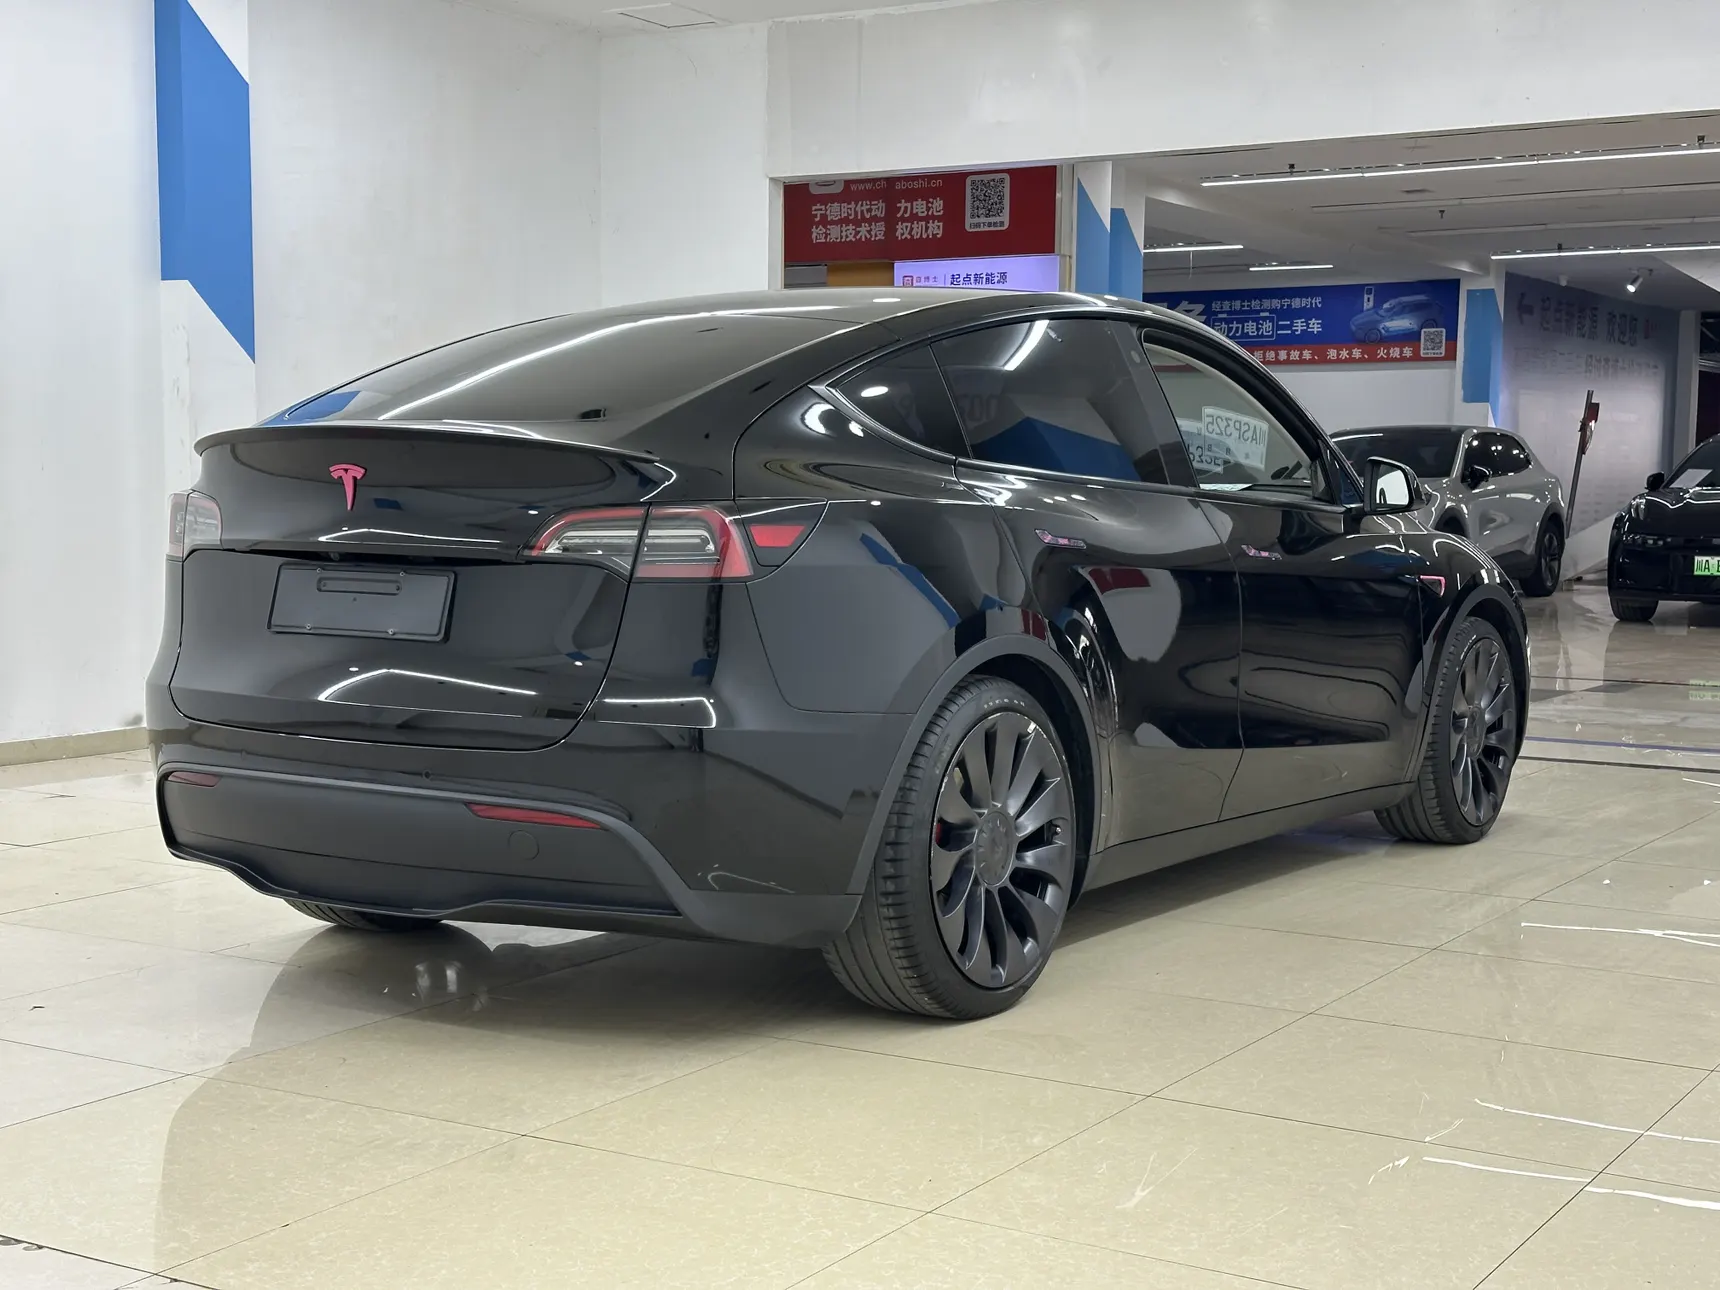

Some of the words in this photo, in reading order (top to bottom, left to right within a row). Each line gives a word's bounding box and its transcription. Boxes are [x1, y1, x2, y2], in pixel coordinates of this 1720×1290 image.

[950, 272, 1008, 286] 起点新能源
